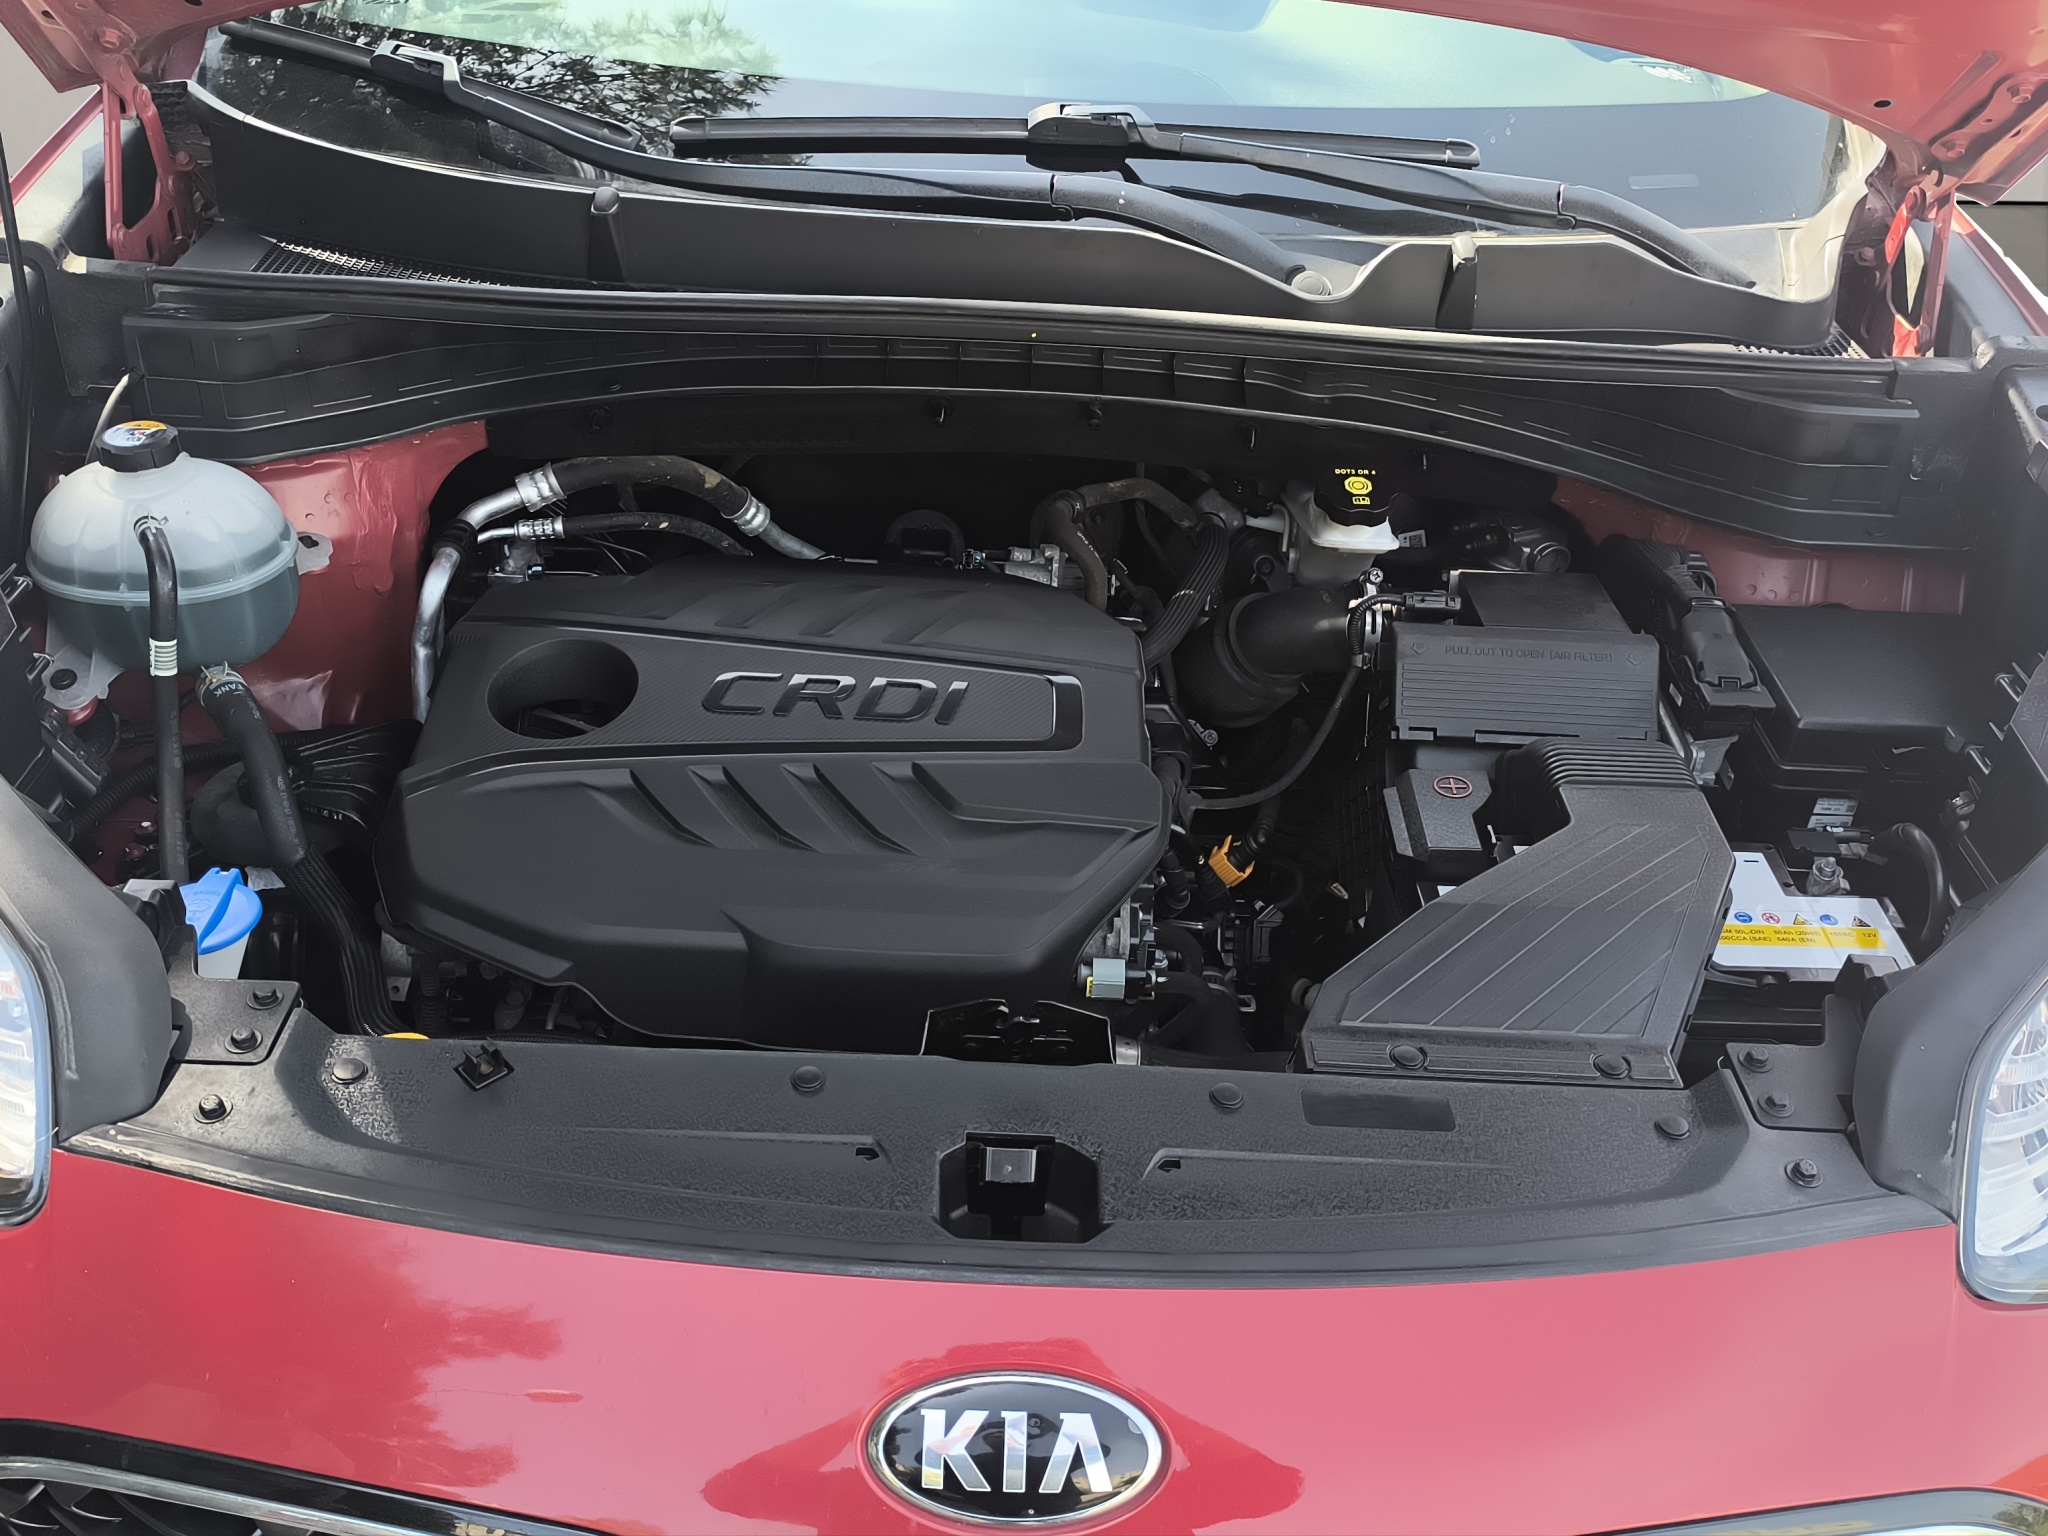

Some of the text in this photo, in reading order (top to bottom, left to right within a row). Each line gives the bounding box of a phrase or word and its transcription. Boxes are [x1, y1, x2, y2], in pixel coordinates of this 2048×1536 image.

[1445, 645, 1613, 663] PULL OUT TO OPEN (AIR FILTER)
[213, 683, 246, 698] TANK
[701, 671, 970, 725] CRDI
[920, 1408, 1113, 1494] KIA
